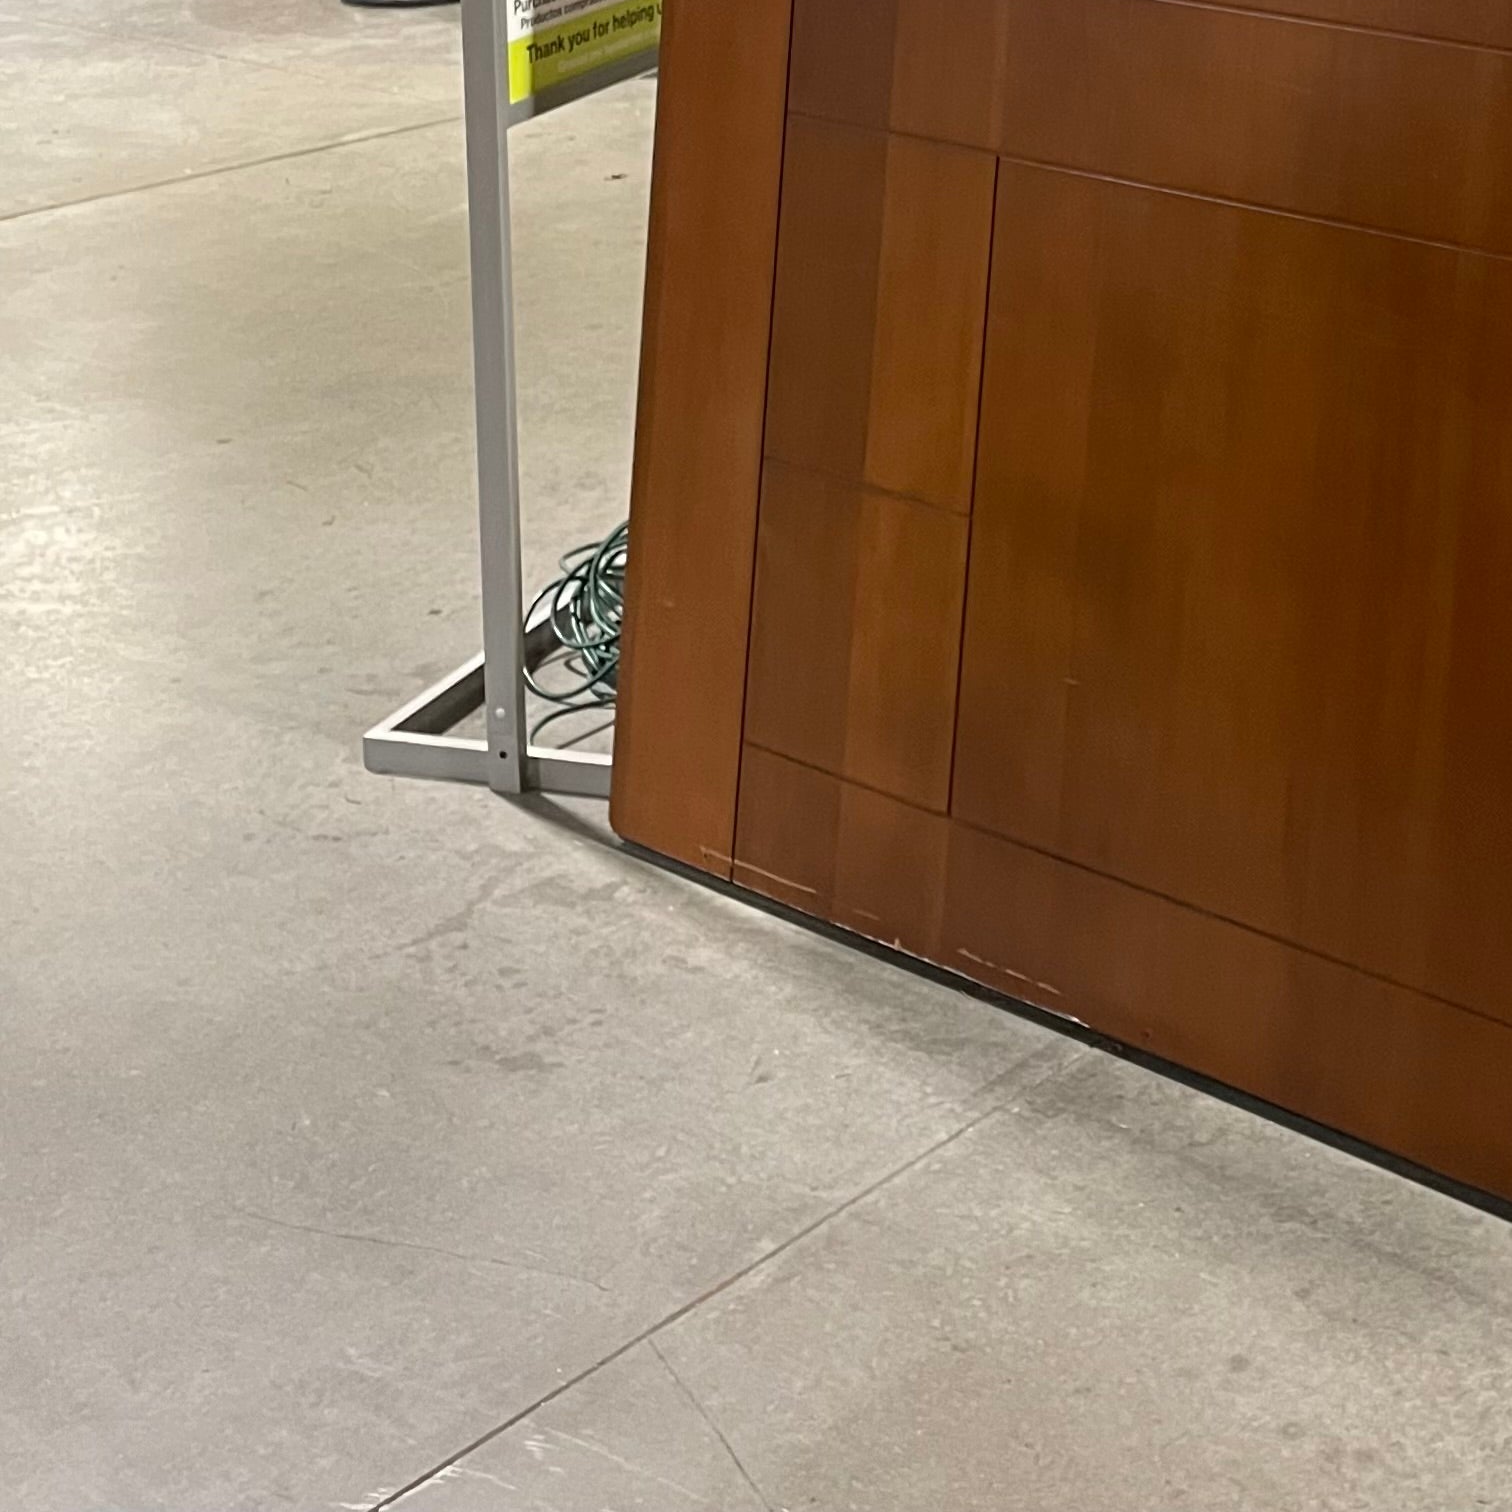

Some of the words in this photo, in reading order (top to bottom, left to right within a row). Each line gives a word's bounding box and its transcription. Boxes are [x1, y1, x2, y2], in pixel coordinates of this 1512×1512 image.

[526, 35, 566, 63] Thank
[568, 32, 590, 52] you
[593, 20, 610, 38] for
[613, 4, 655, 31] helping
